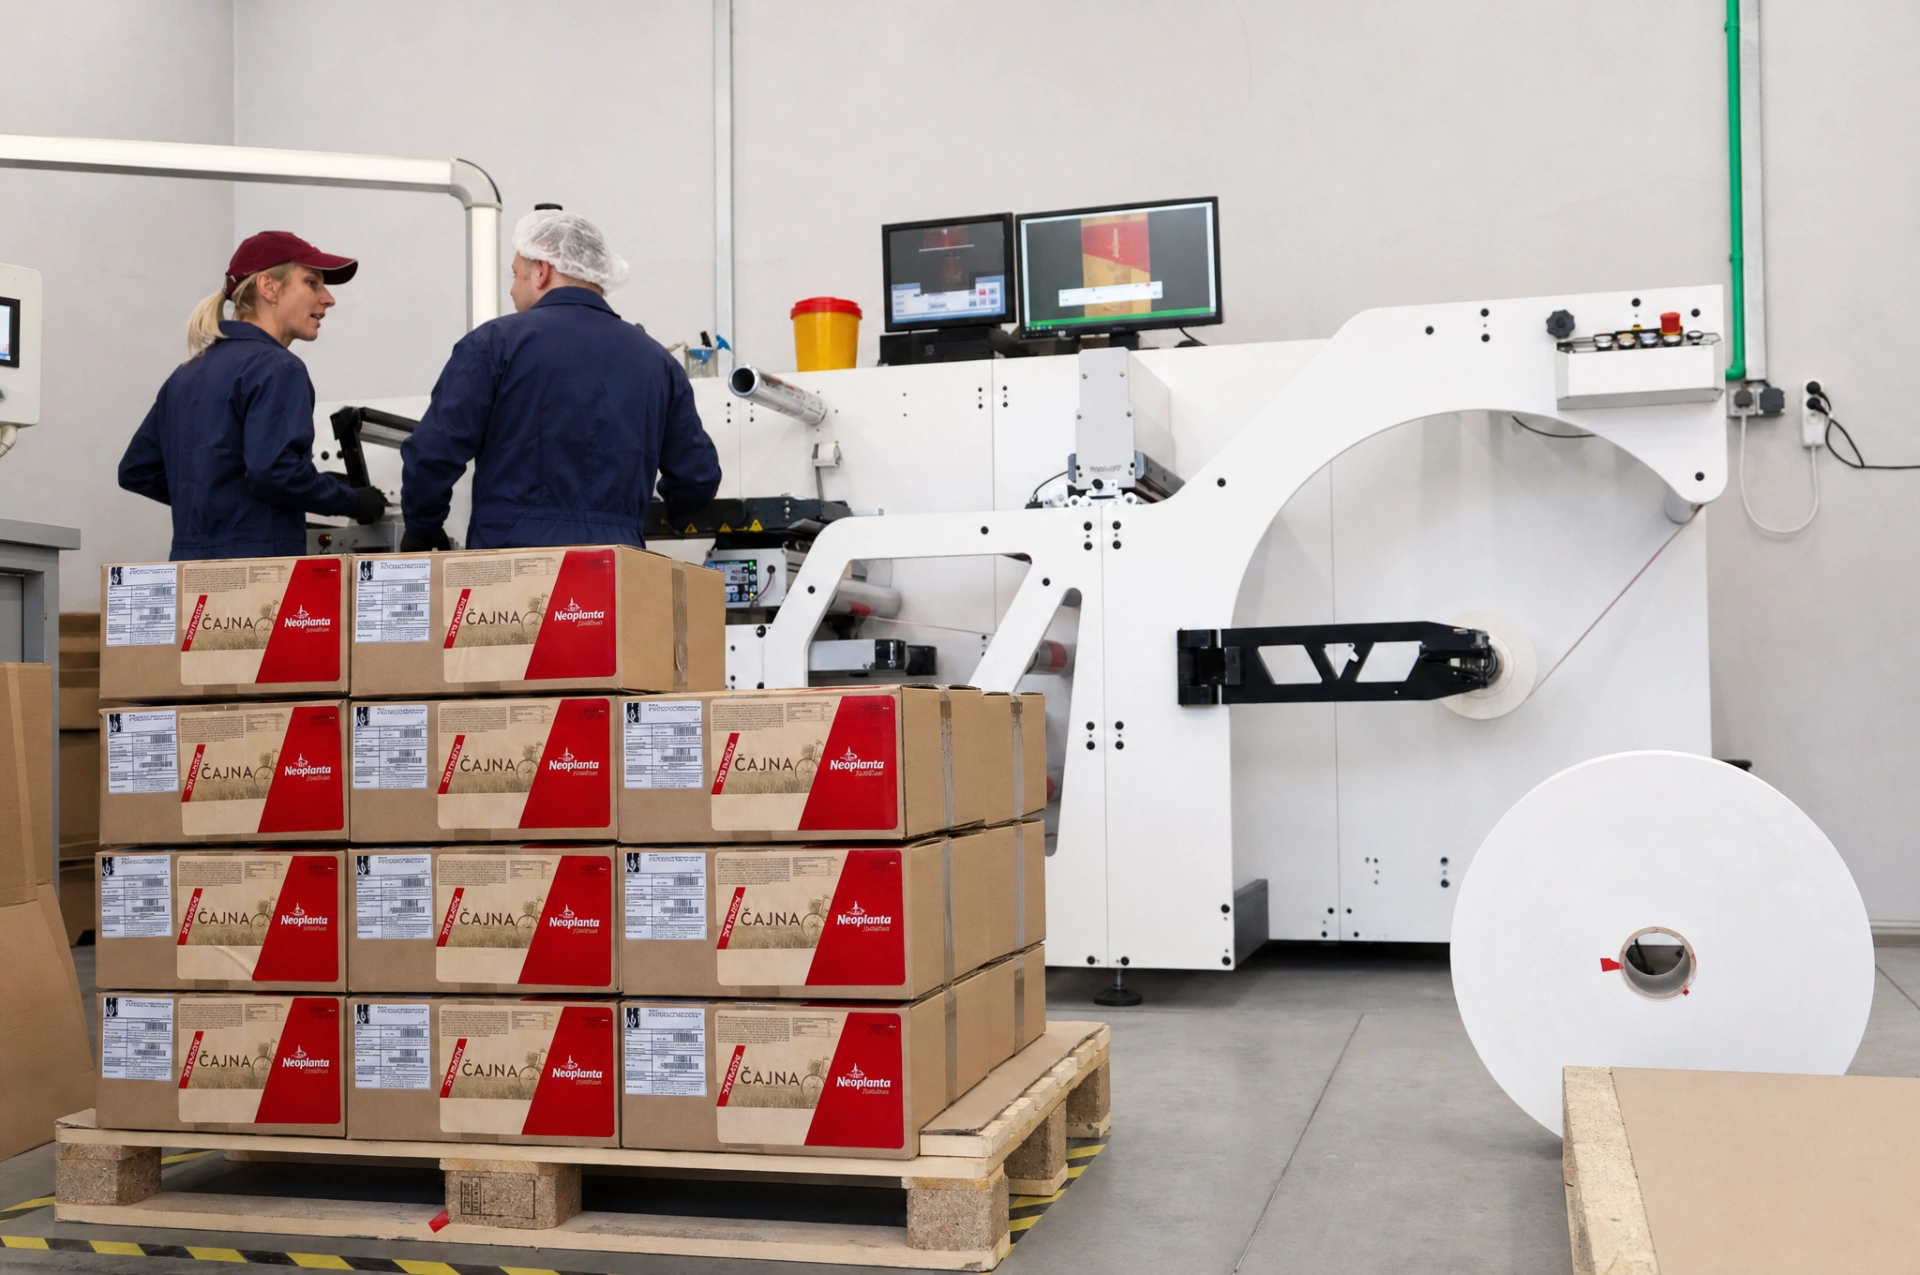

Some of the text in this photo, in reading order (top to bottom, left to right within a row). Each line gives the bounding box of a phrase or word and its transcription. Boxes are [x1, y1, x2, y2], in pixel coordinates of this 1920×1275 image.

[202, 613, 253, 630] ČAJNA
[284, 616, 331, 628] Neoplanta
[466, 608, 521, 625] ČAJNA
[554, 609, 605, 622] Neoplanta
[460, 755, 515, 772] ČAJNA
[548, 760, 599, 772] Neoplanta
[735, 753, 793, 771] ČAJNA
[829, 759, 884, 771] Neoplanta
[201, 763, 253, 780] ČAJNA
[284, 766, 331, 777] Neoplanta
[198, 907, 249, 925] ČAJNA
[280, 914, 328, 926] Neoplanta
[459, 907, 515, 926] ČAJNA
[549, 916, 600, 928] Neoplanta
[741, 908, 800, 926] ČAJNA
[837, 914, 891, 926] Neoplanta
[199, 1050, 251, 1068] ČAJNA
[282, 1057, 329, 1069] Neoplanta
[462, 1059, 517, 1078] ČAJNA
[552, 1067, 602, 1080] Neoplanta
[740, 1066, 800, 1086] ČAJNA
[836, 1076, 891, 1089] Neoplanta
